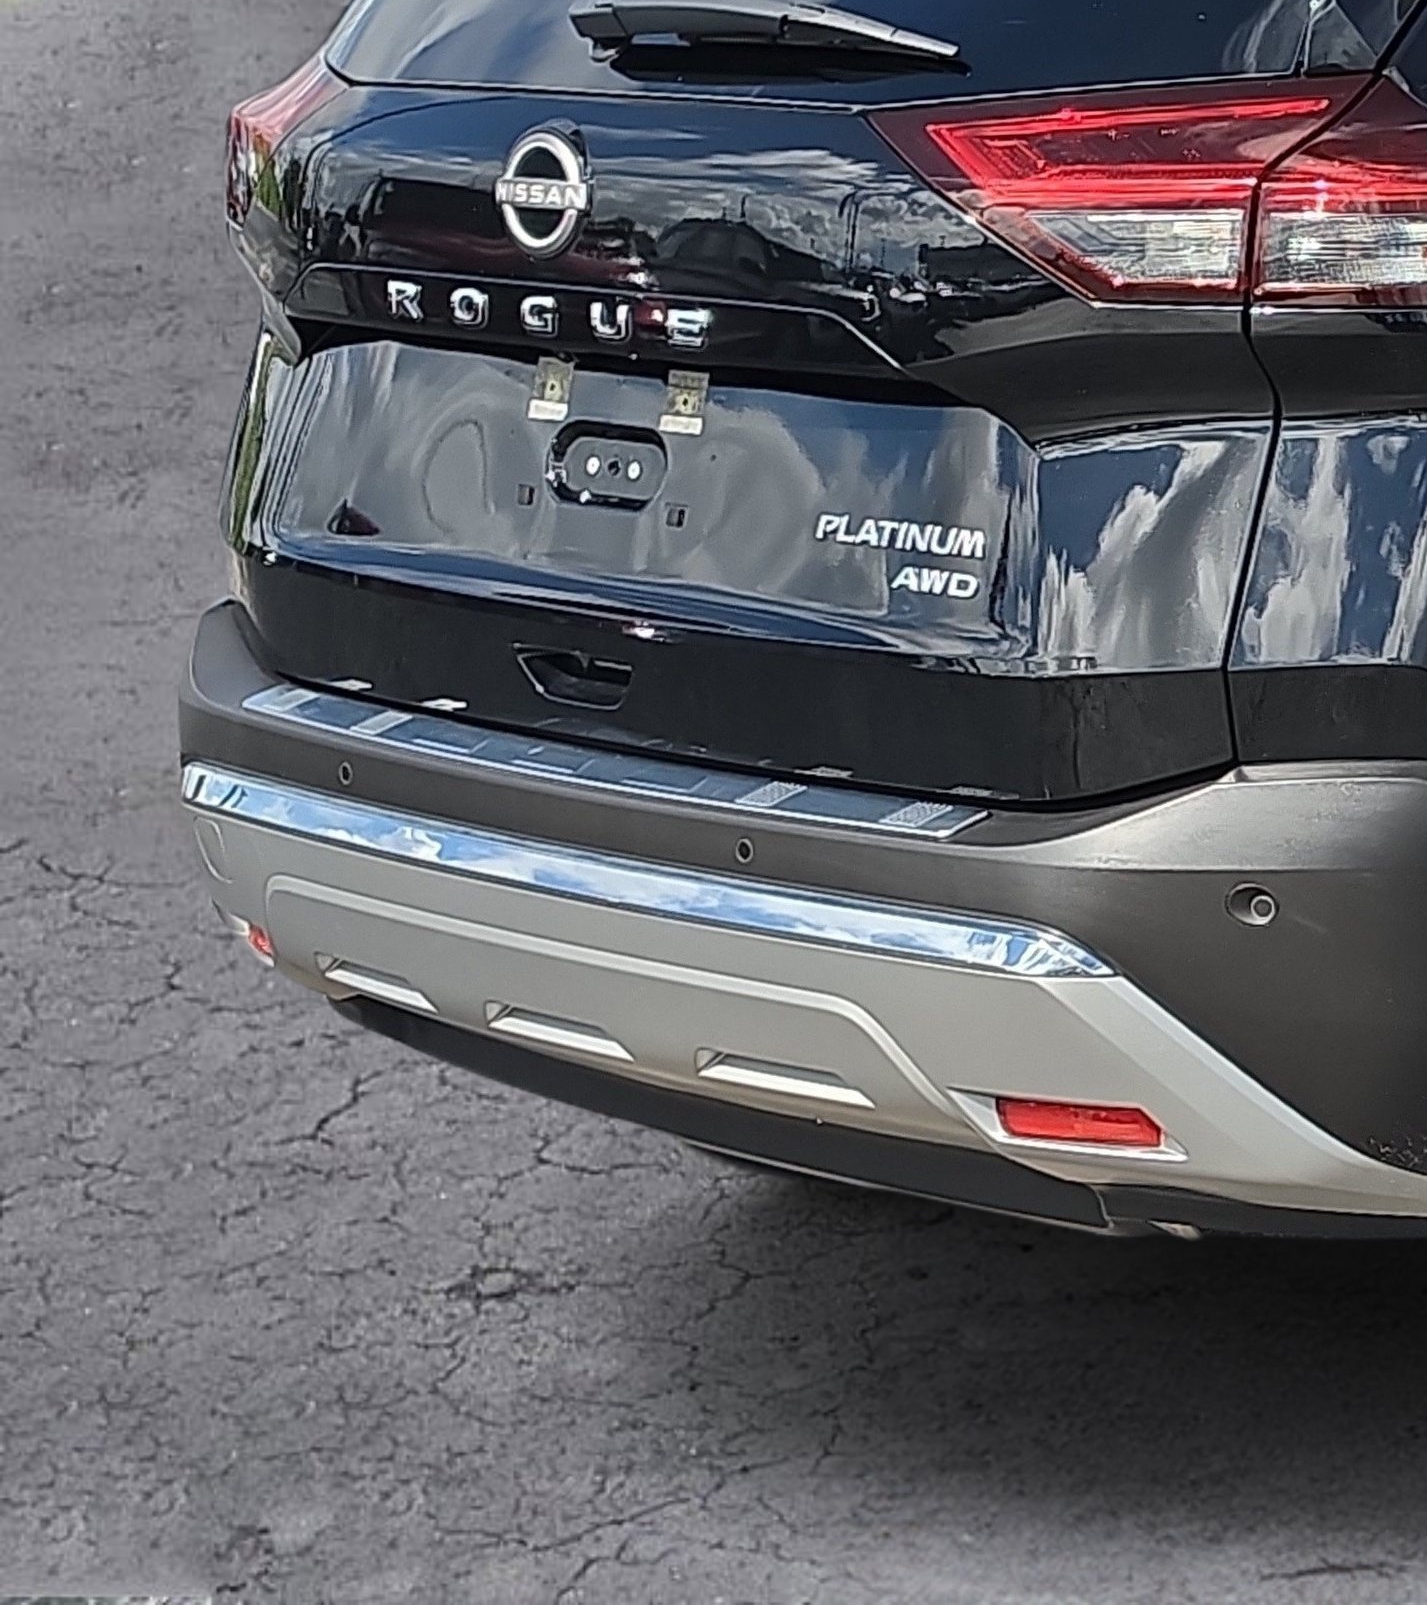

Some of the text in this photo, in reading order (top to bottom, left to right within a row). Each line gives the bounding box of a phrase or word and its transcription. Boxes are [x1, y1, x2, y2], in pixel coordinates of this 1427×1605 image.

[496, 180, 587, 209] NISSAN
[387, 279, 712, 351] ROGUE
[815, 513, 986, 558] PLATINUM
[890, 566, 978, 598] AWD
